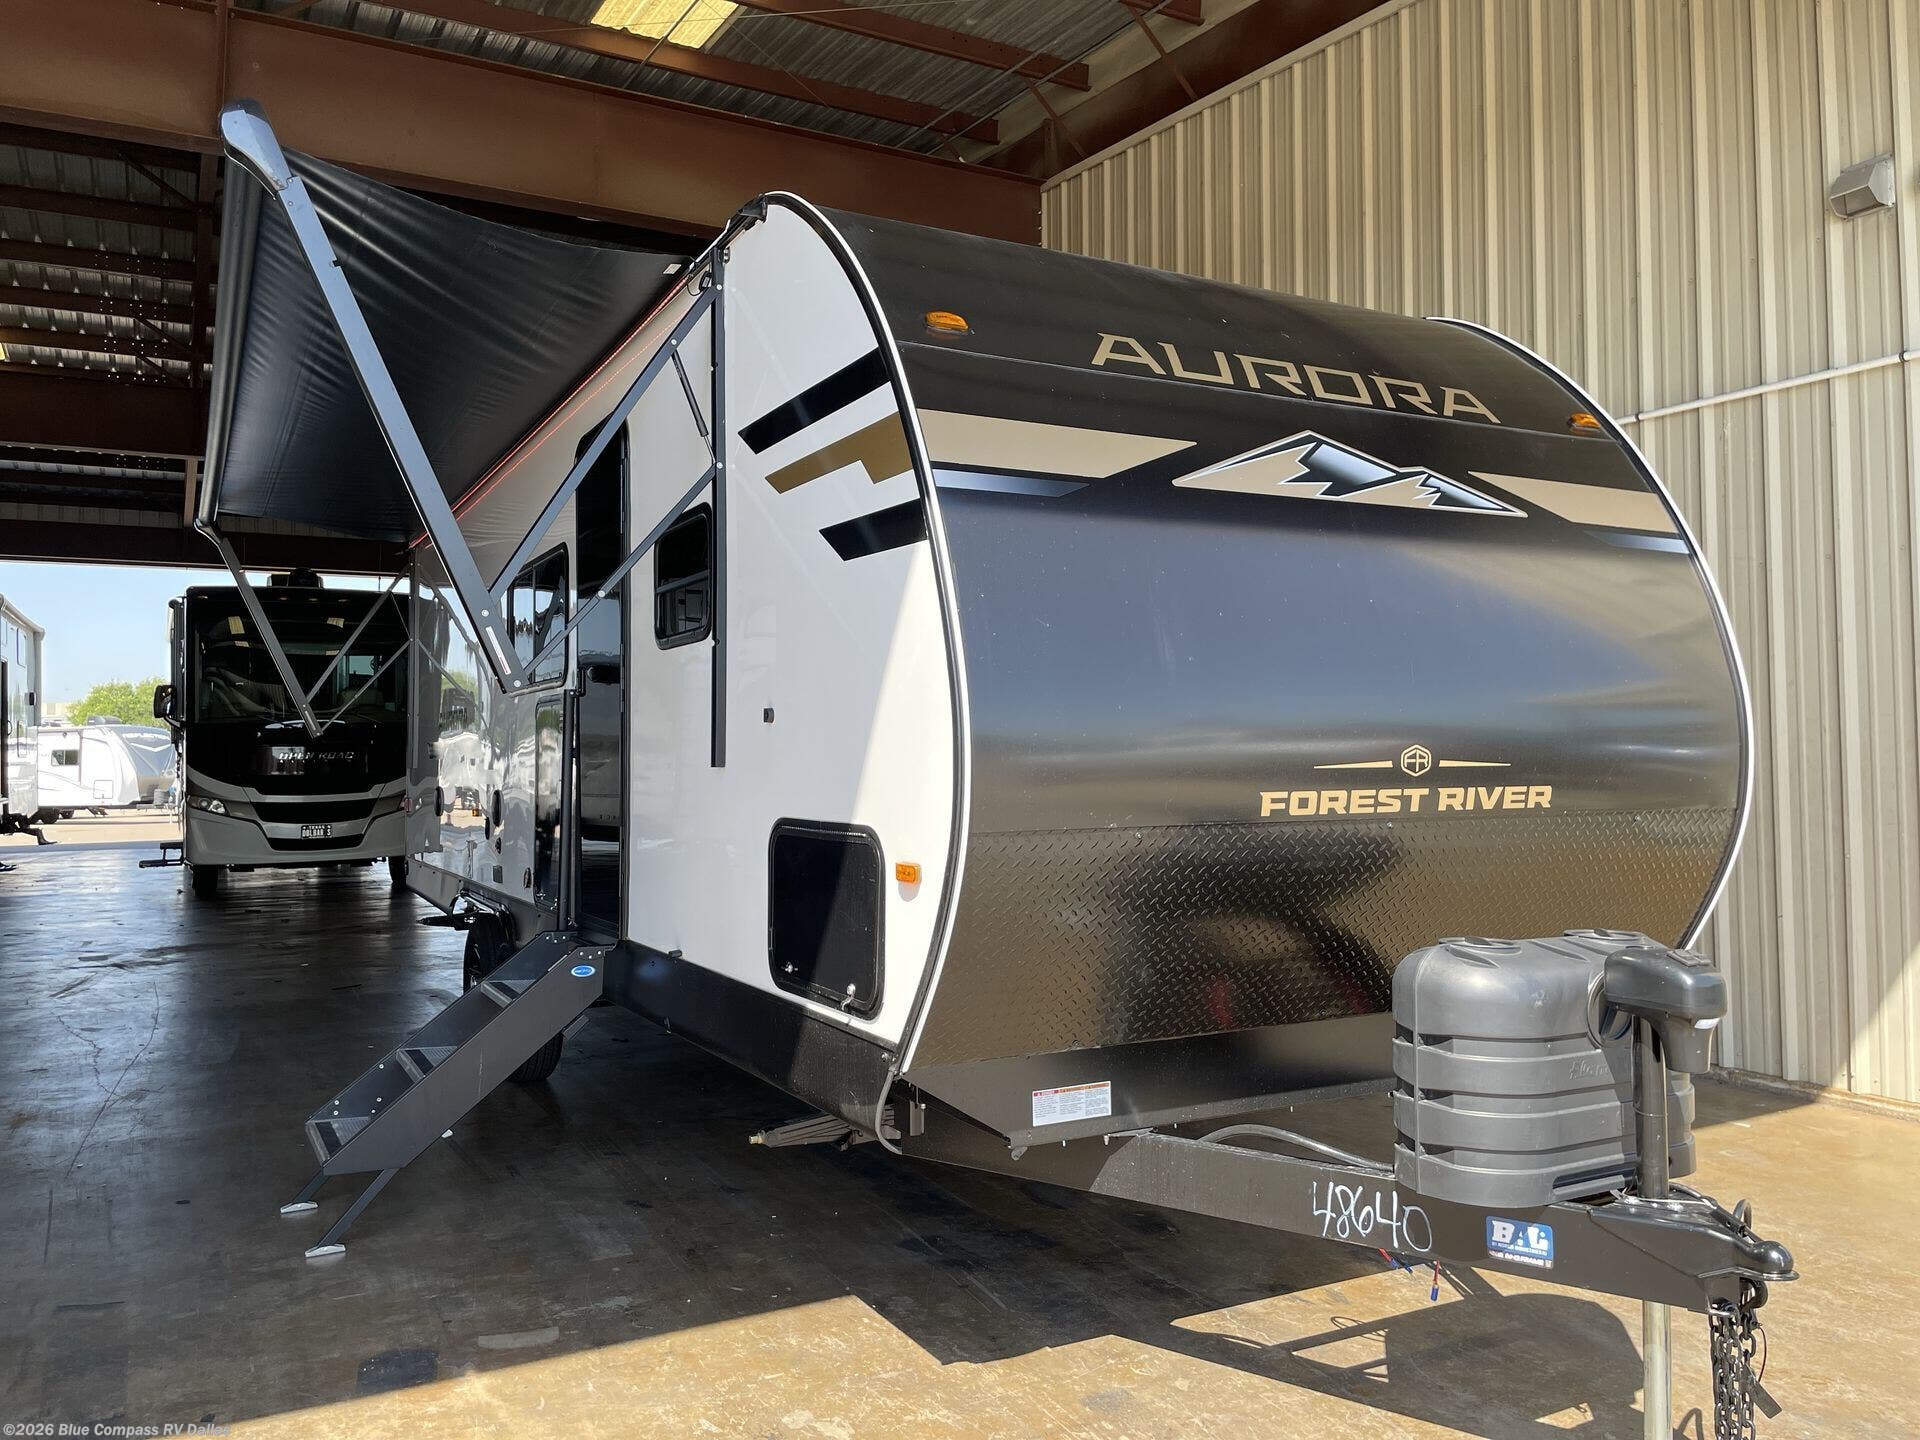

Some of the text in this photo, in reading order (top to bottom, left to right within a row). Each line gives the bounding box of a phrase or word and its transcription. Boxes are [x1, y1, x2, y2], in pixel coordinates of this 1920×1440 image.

[1091, 332, 1501, 424] AURORA
[1259, 785, 1553, 817] FOREST RIVER
[1312, 1181, 1433, 1252] 48640
